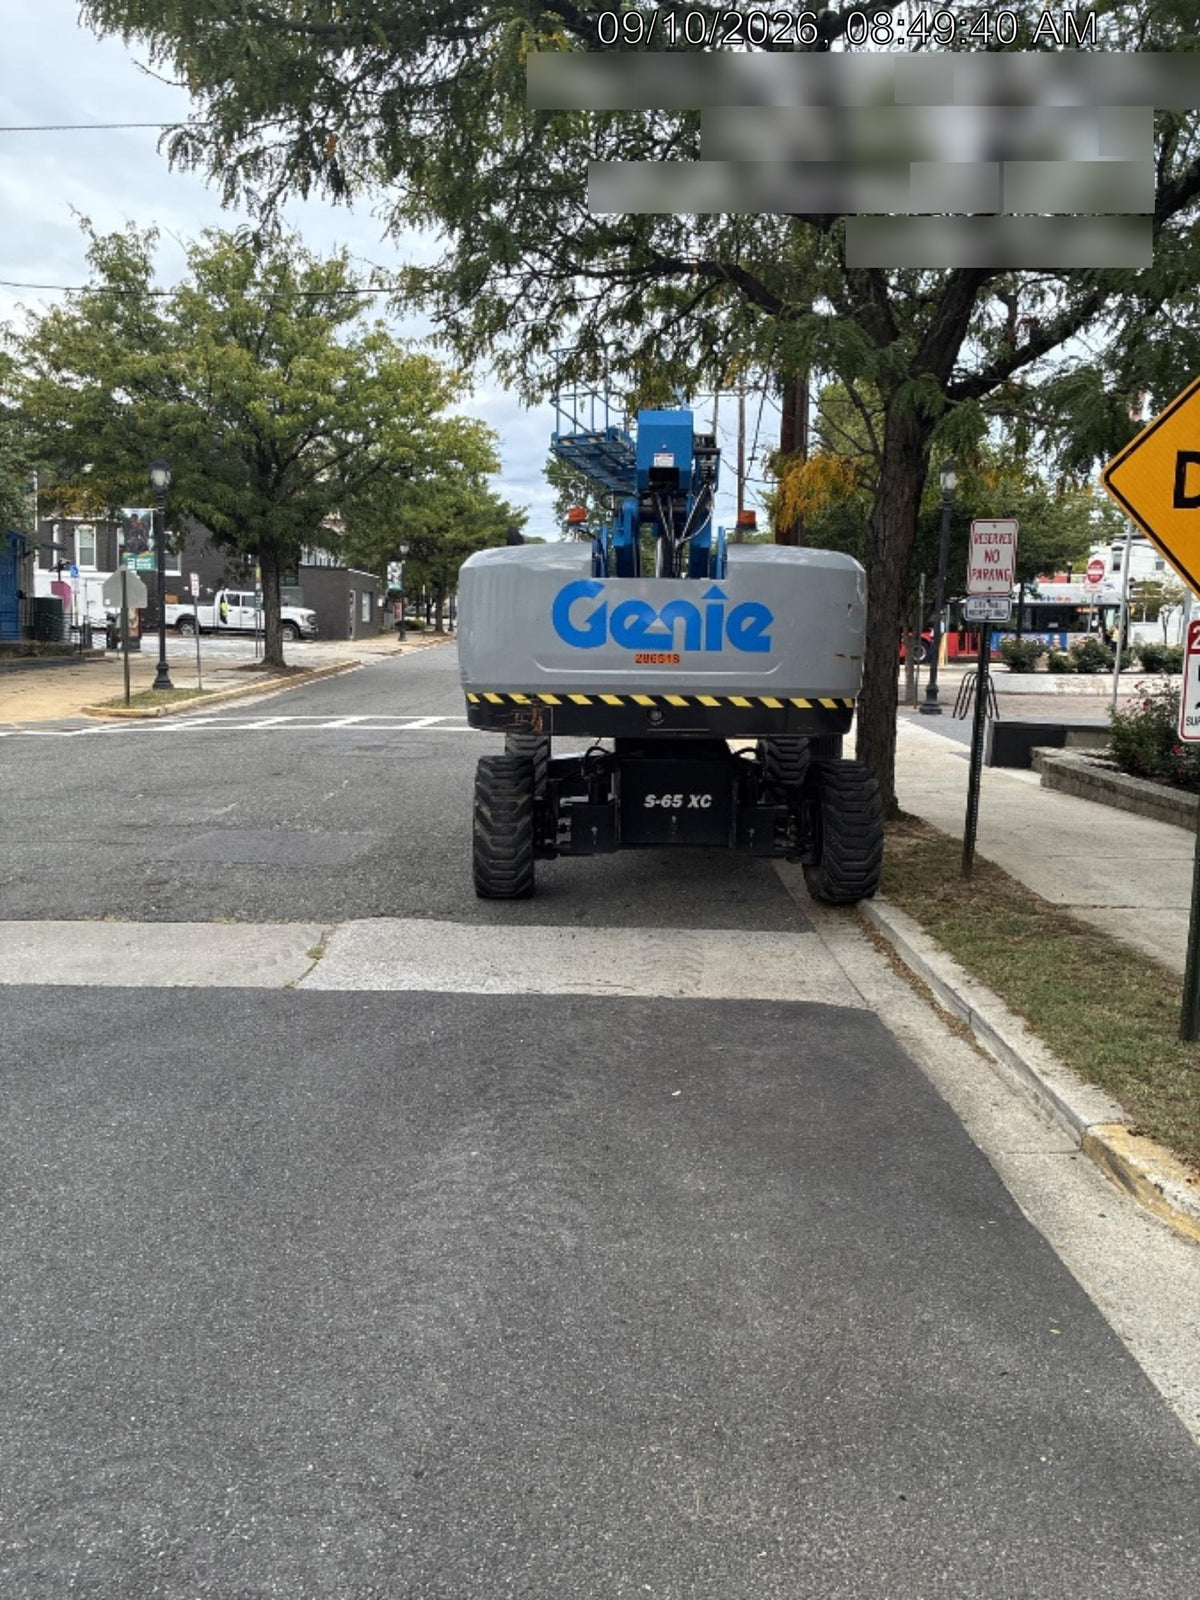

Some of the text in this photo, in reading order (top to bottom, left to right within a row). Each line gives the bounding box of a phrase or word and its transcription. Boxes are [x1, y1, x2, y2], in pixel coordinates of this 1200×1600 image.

[984, 549, 1000, 564] NO
[971, 568, 1011, 582] PARKING
[552, 579, 774, 653] Genie
[643, 793, 712, 808] S-65 XC
